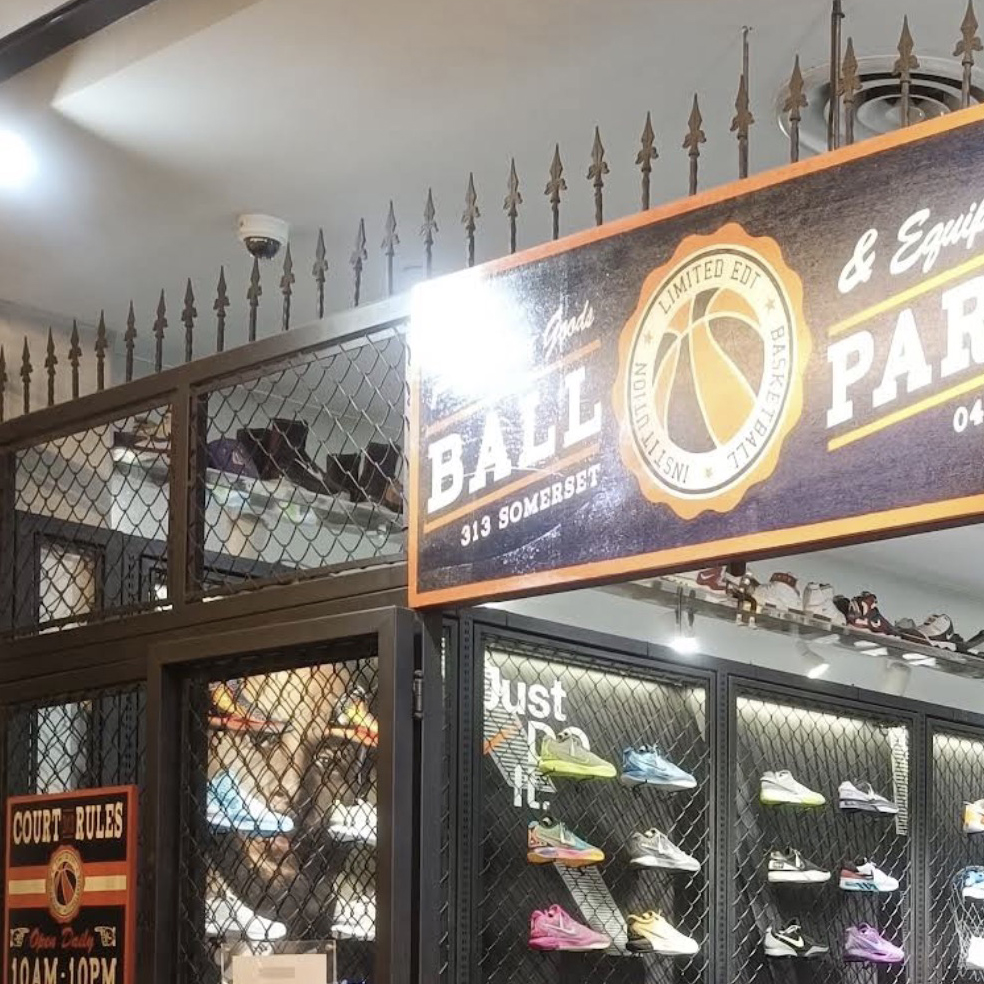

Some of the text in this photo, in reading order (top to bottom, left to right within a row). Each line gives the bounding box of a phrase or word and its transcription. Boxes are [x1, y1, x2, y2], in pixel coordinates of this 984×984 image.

[658, 258, 762, 314] LIMITED EDT
[837, 228, 879, 293] &
[543, 299, 596, 358] Goods
[631, 361, 689, 485] INSTITUTION
[727, 324, 786, 469] BASKETBALL
[426, 366, 602, 515] BALL
[460, 463, 601, 547] 313 SOMERSET
[484, 664, 567, 722] Just
[13, 808, 62, 845] COURT
[75, 801, 123, 841] RULES
[29, 926, 95, 954] Open Daily
